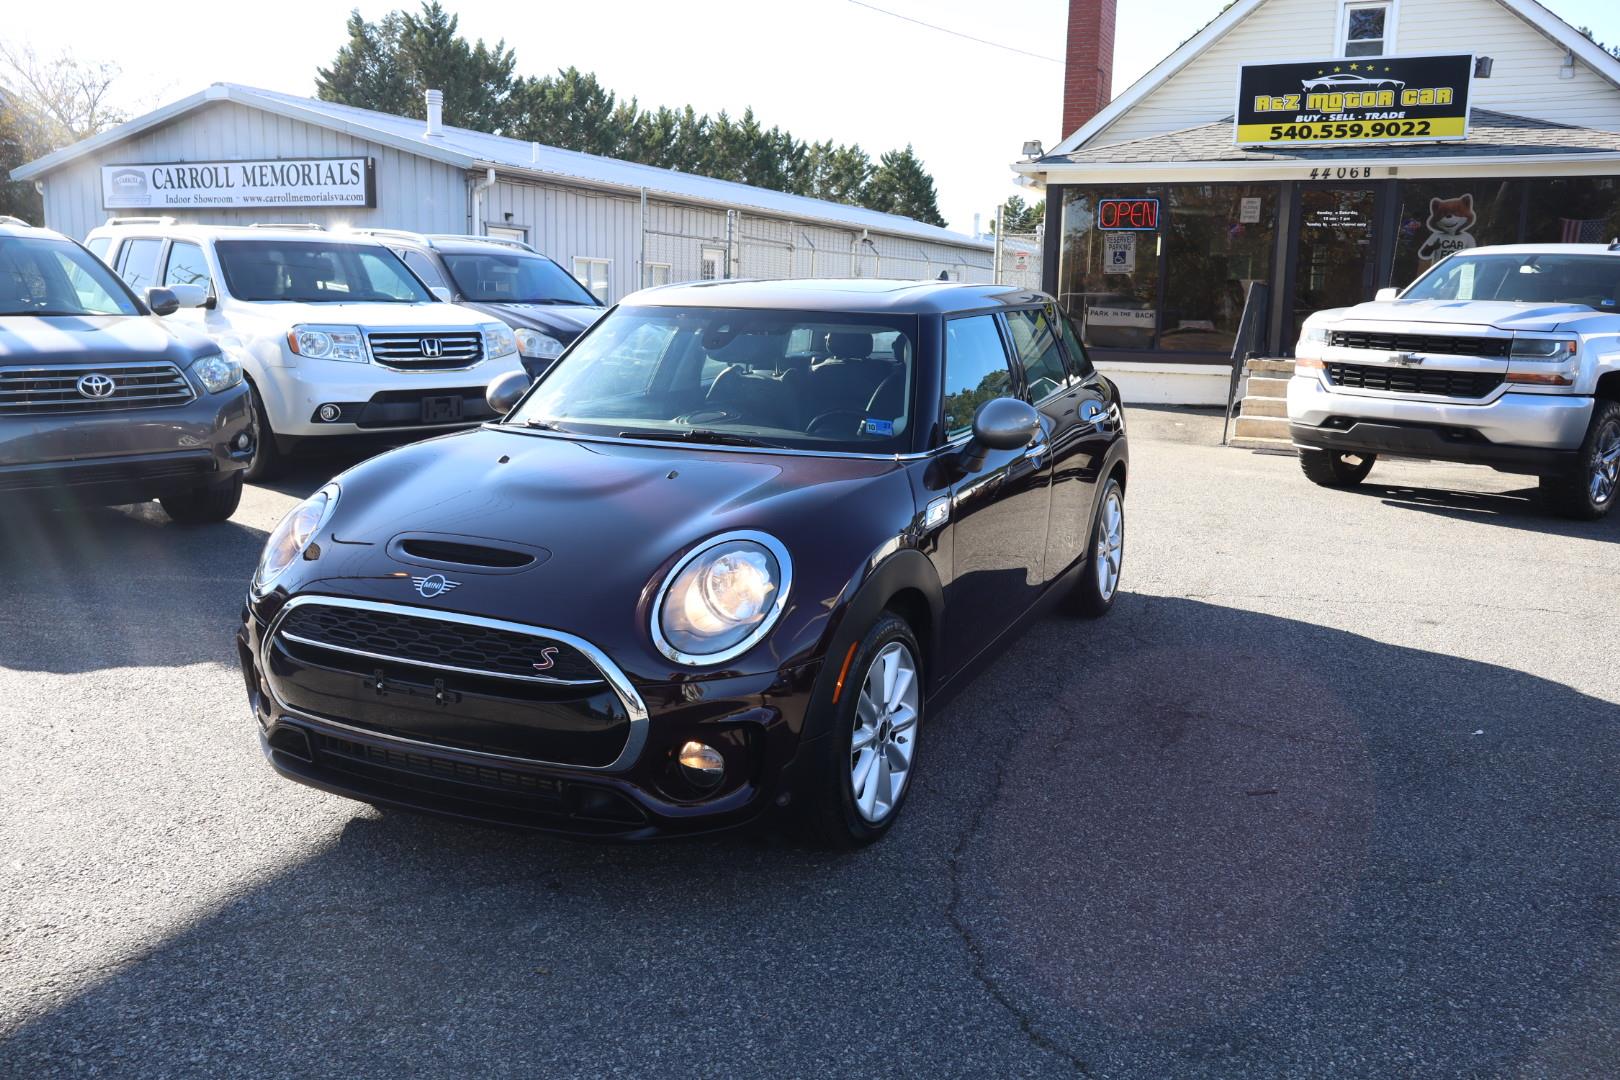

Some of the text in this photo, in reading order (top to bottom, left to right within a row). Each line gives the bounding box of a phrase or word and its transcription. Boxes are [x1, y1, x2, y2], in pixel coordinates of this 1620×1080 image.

[1295, 111, 1406, 122] BUY SELL TRADE
[1269, 121, 1431, 140] 540.559.9022
[152, 162, 361, 190] CARROLL MEMORIALS
[165, 192, 365, 204] Indoor Showroom www.carrollmemorialsva.com
[1101, 202, 1156, 227] OPEN
[1441, 239, 1464, 250] CAR
[423, 581, 442, 590] MINI
[532, 646, 559, 670] S
